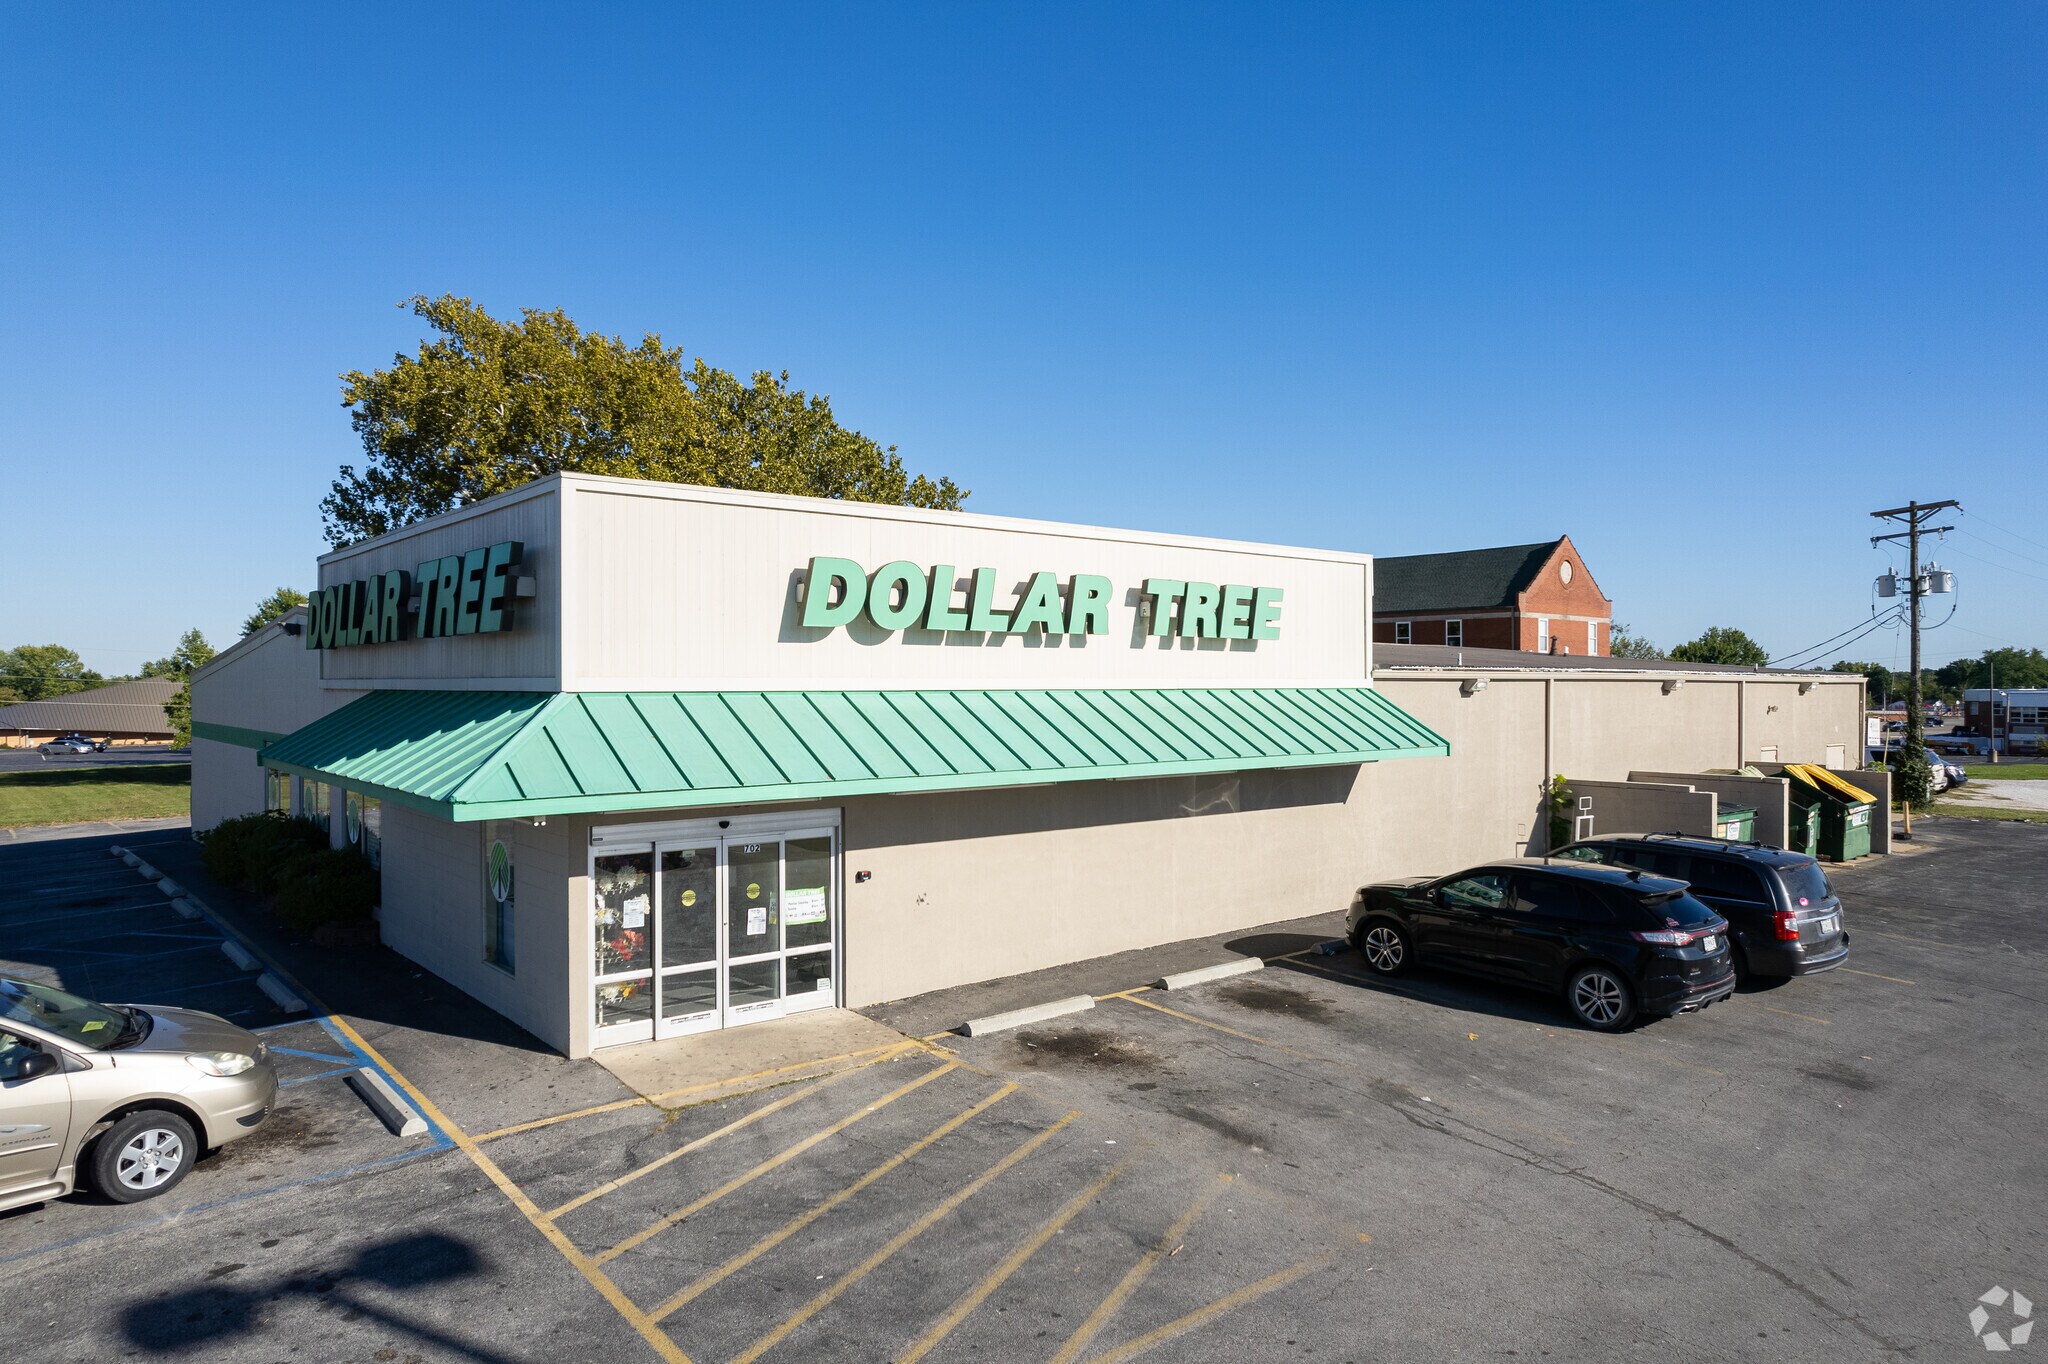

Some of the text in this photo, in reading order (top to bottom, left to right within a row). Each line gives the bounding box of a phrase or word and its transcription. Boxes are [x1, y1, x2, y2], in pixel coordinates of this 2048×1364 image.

[305, 540, 524, 650] DOLLAR TREE
[802, 556, 1284, 640] DOLLAR TREE
[745, 845, 760, 853] 702
